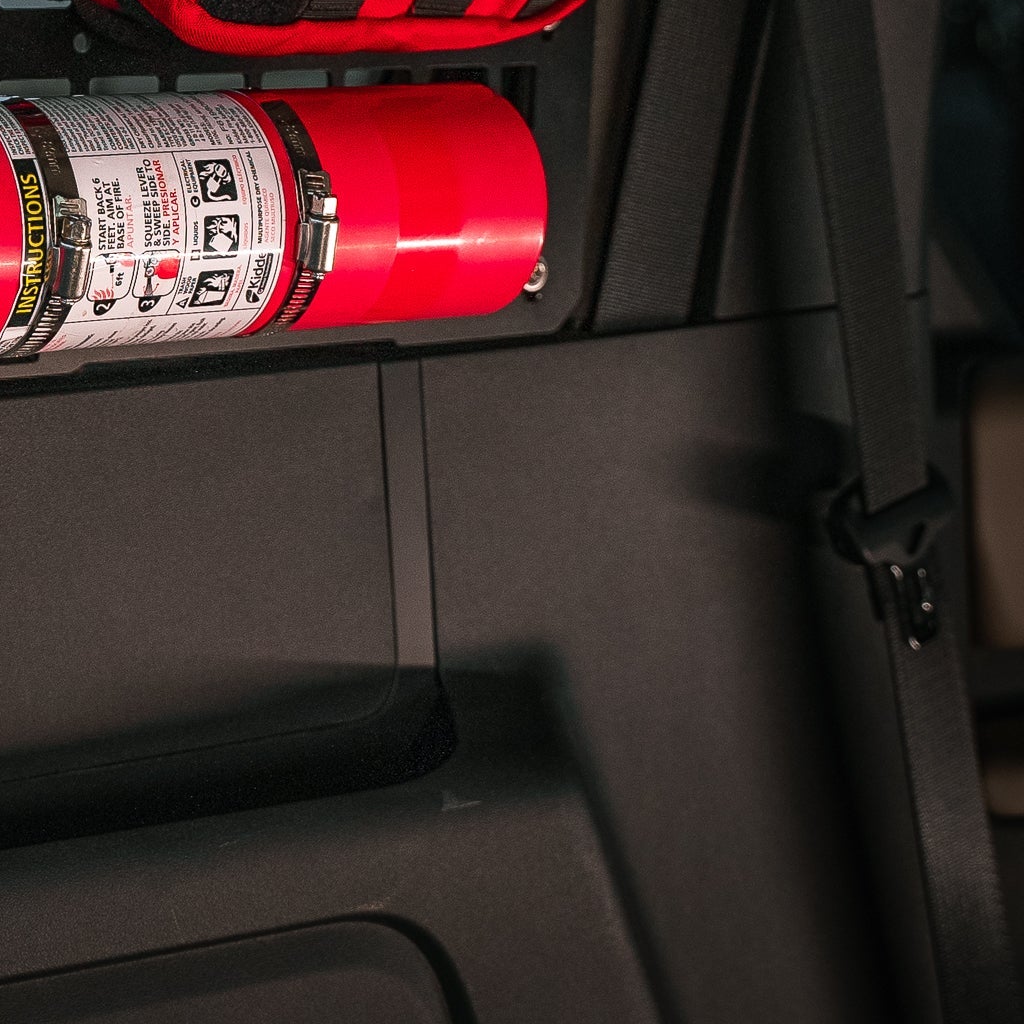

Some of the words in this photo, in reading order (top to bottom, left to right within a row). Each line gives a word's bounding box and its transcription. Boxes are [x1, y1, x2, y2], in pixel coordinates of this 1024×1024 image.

[143, 159, 153, 172] TO
[180, 160, 192, 193] ELECTRICAL
[186, 159, 198, 192] EQUIPMENT
[246, 151, 258, 181] CHEMICAL
[102, 182, 110, 195] AT
[112, 178, 122, 202] FIRE.
[136, 167, 149, 197] LEVER
[147, 175, 158, 197] SIDE
[153, 159, 170, 216] PRESIONAR
[95, 188, 104, 214] BACK
[106, 199, 114, 219] AIM
[115, 205, 123, 219] OF
[170, 189, 180, 235] APLICAR.
[125, 195, 134, 248] APUNTAR.
[142, 200, 153, 247] SQUEEZE
[152, 200, 161, 235] SWEEP
[15, 172, 42, 315] INSTRUCTIONS
[107, 222, 115, 249] FEET.
[117, 222, 125, 249] BASE
[154, 238, 161, 246] &
[162, 220, 171, 246] SIDE.
[115, 272, 124, 286] 6ft
[247, 253, 266, 289] Kidde
[178, 277, 186, 294] TRASH
[98, 303, 110, 311] 2
